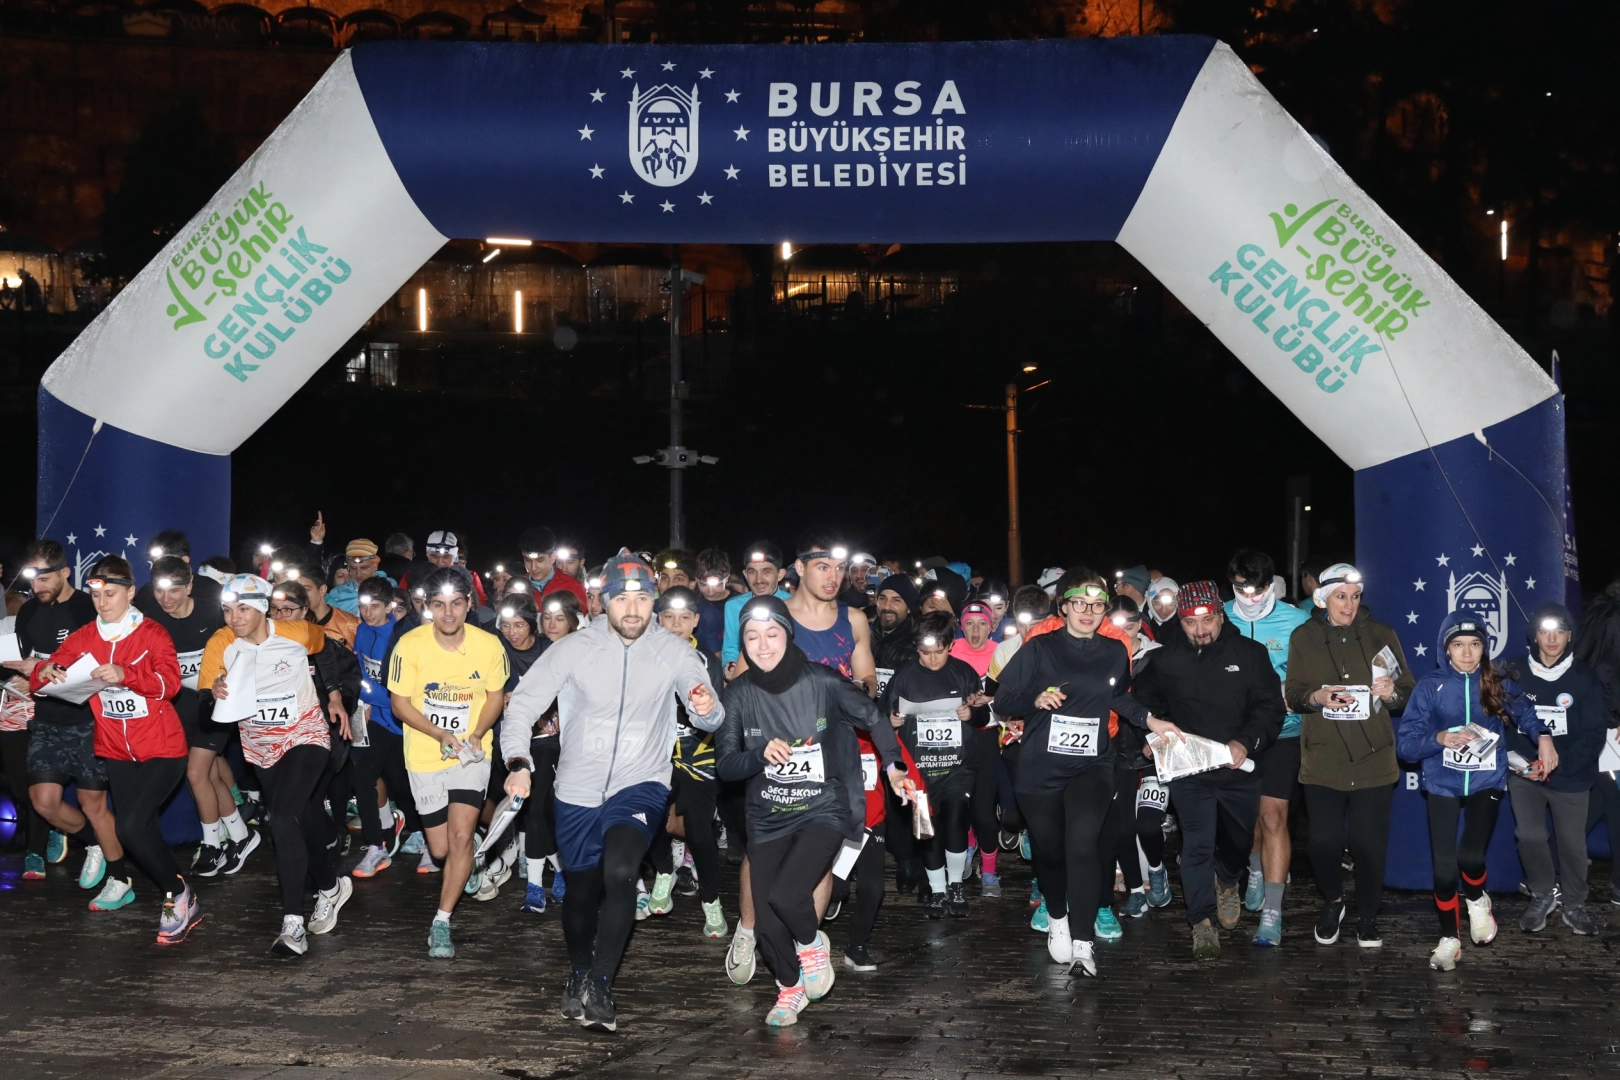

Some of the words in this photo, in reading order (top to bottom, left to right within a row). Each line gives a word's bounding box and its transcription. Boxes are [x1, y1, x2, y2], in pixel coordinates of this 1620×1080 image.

[769, 80, 967, 117] BURSA
[768, 118, 966, 156] BÜYÜKŞEHİR
[768, 154, 967, 187] BELEDİYESİ
[223, 256, 352, 383] KULÜBÜ
[1208, 260, 1348, 394] KULÜBÜ
[431, 692, 458, 702] WORLD
[458, 692, 474, 702] RUN
[108, 699, 136, 713] 108
[258, 706, 289, 720] 174
[430, 713, 460, 729] 016
[926, 728, 953, 741] 032
[1059, 732, 1090, 748] 222
[595, 737, 632, 755] 07
[776, 760, 812, 776] 224
[767, 785, 789, 796] GECE
[1143, 789, 1166, 803] 008
